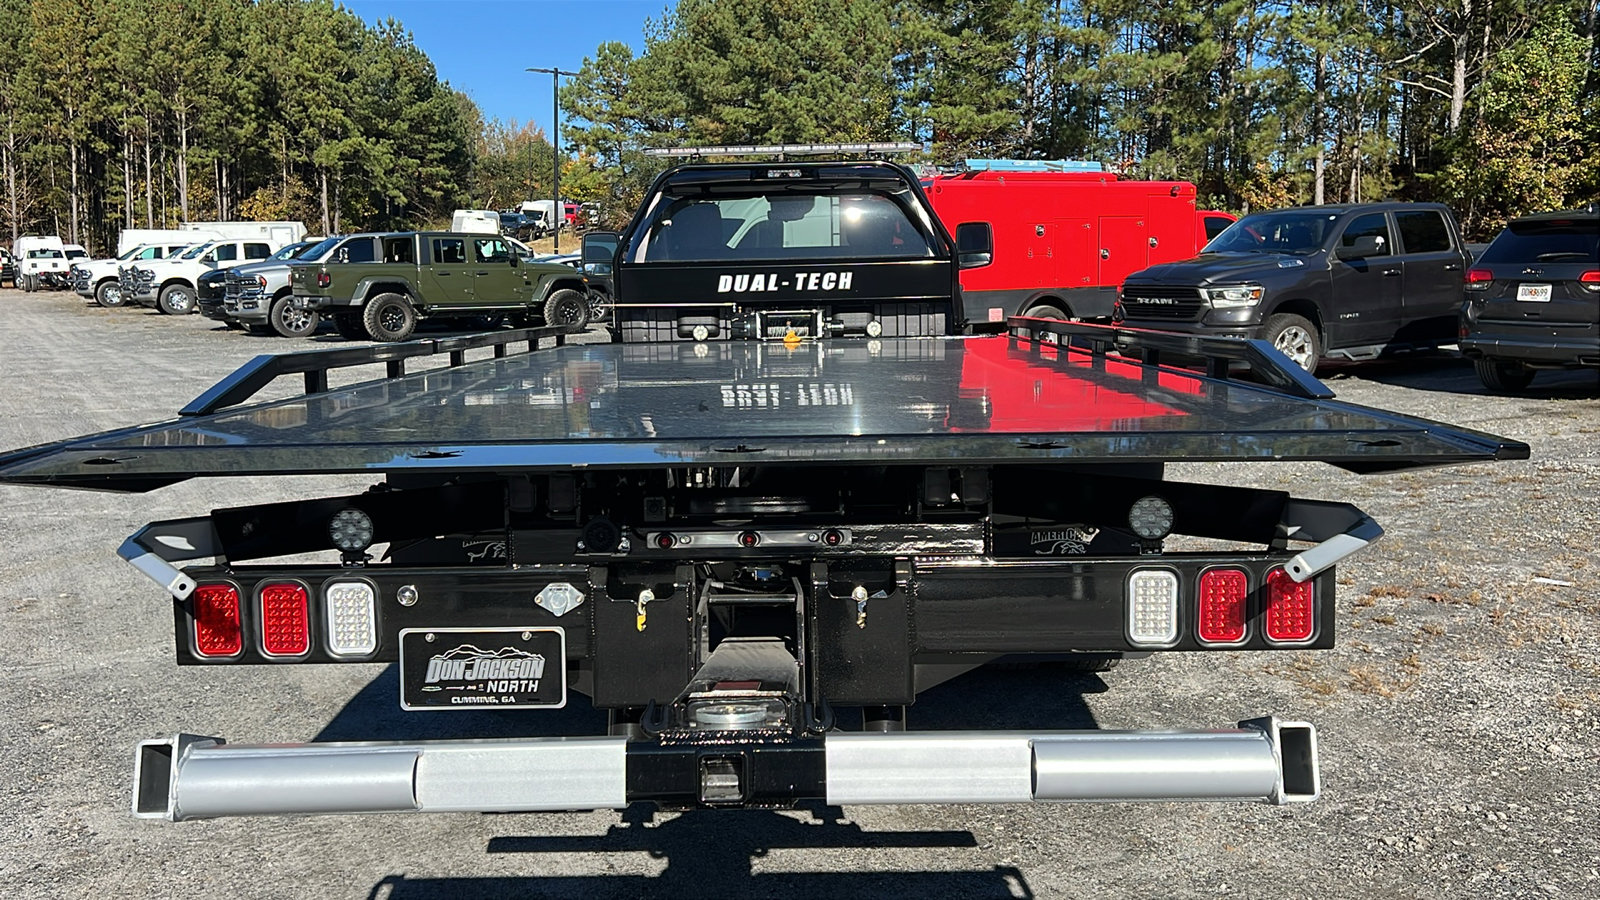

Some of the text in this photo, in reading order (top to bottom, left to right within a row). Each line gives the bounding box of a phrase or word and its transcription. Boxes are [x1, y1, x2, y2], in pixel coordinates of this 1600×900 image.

[717, 271, 853, 293] DUAL-TECH
[1136, 297, 1173, 305] RAM
[424, 658, 546, 684] DON JACKSON
[486, 680, 539, 693] NORTH
[451, 696, 499, 704] CUMMING,
